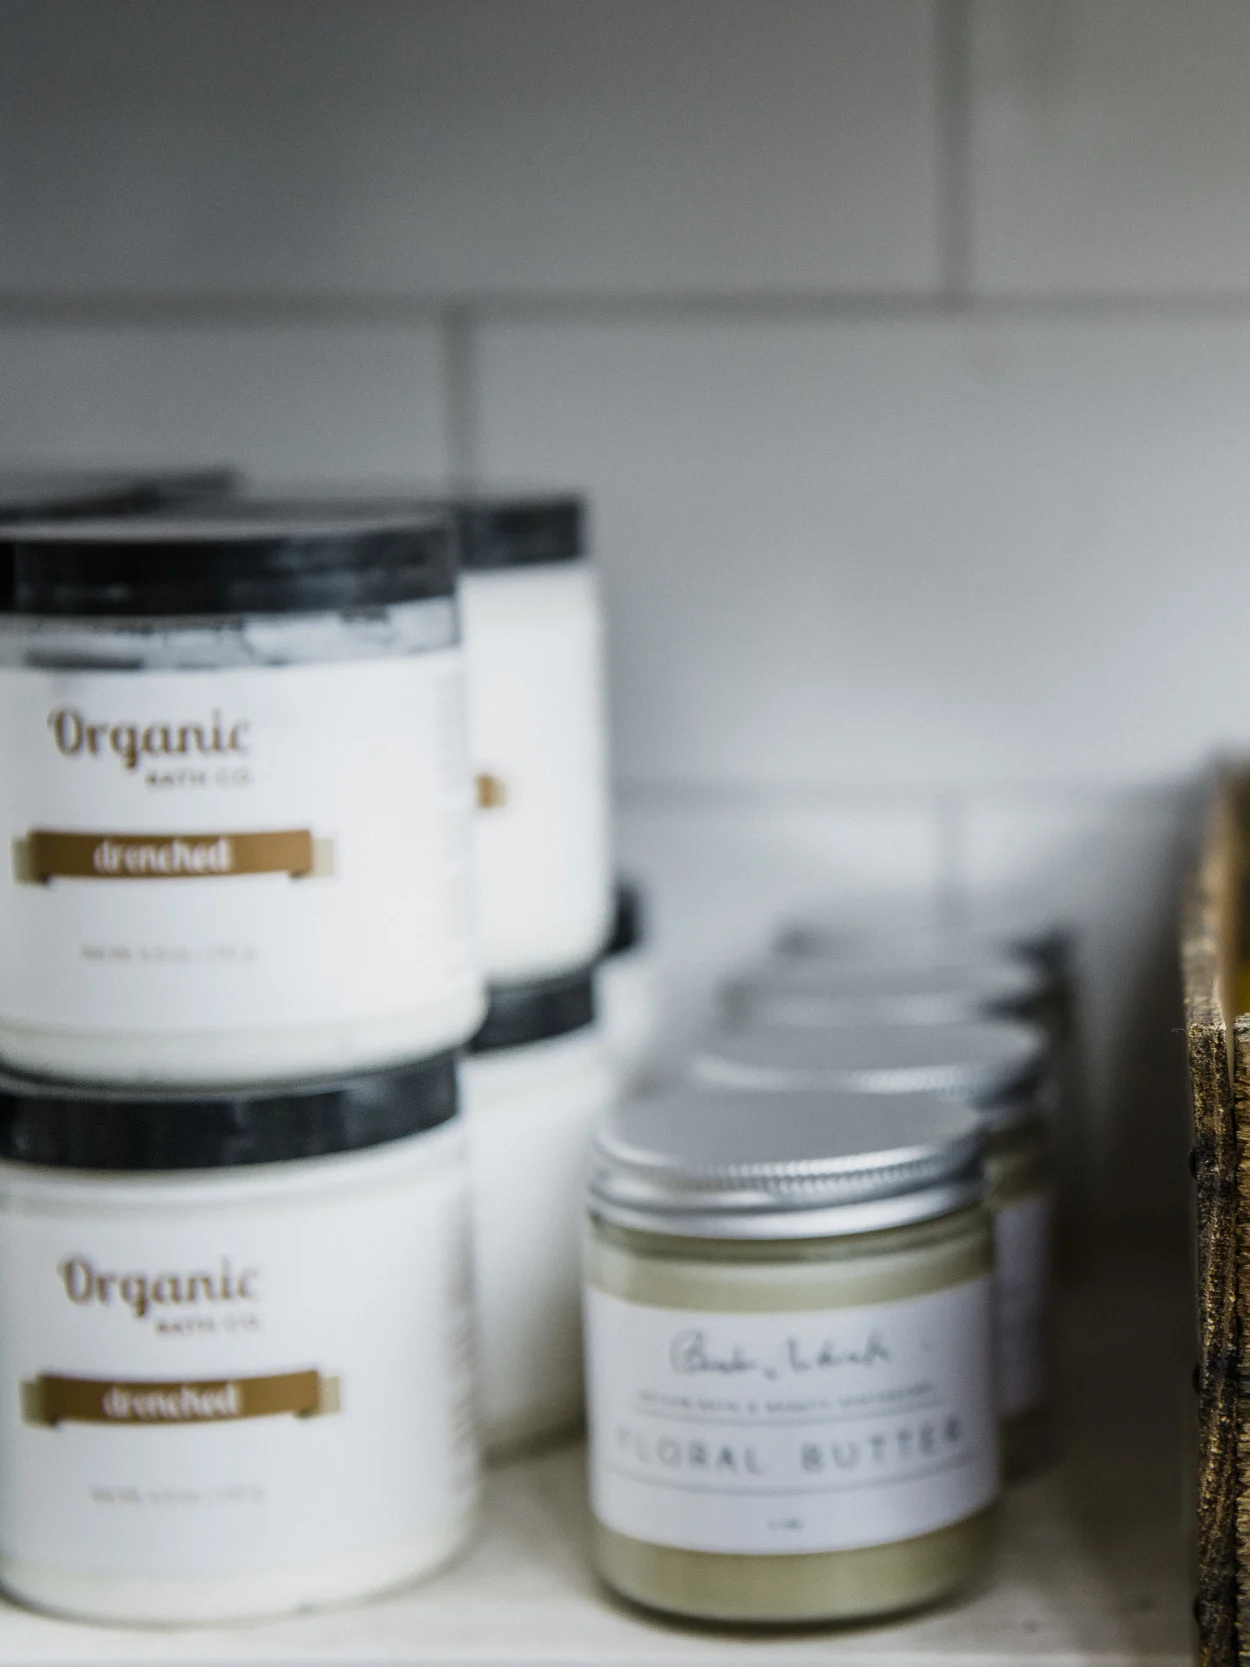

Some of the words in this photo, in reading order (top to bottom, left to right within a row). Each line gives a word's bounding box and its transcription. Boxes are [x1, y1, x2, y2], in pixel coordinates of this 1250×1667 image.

[47, 706, 253, 769] Organic
[93, 837, 233, 873] drenched
[57, 1255, 260, 1318] Organic
[102, 1382, 241, 1419] drenched
[614, 1428, 764, 1475] FLORAL
[801, 1416, 964, 1473] BUTTER
